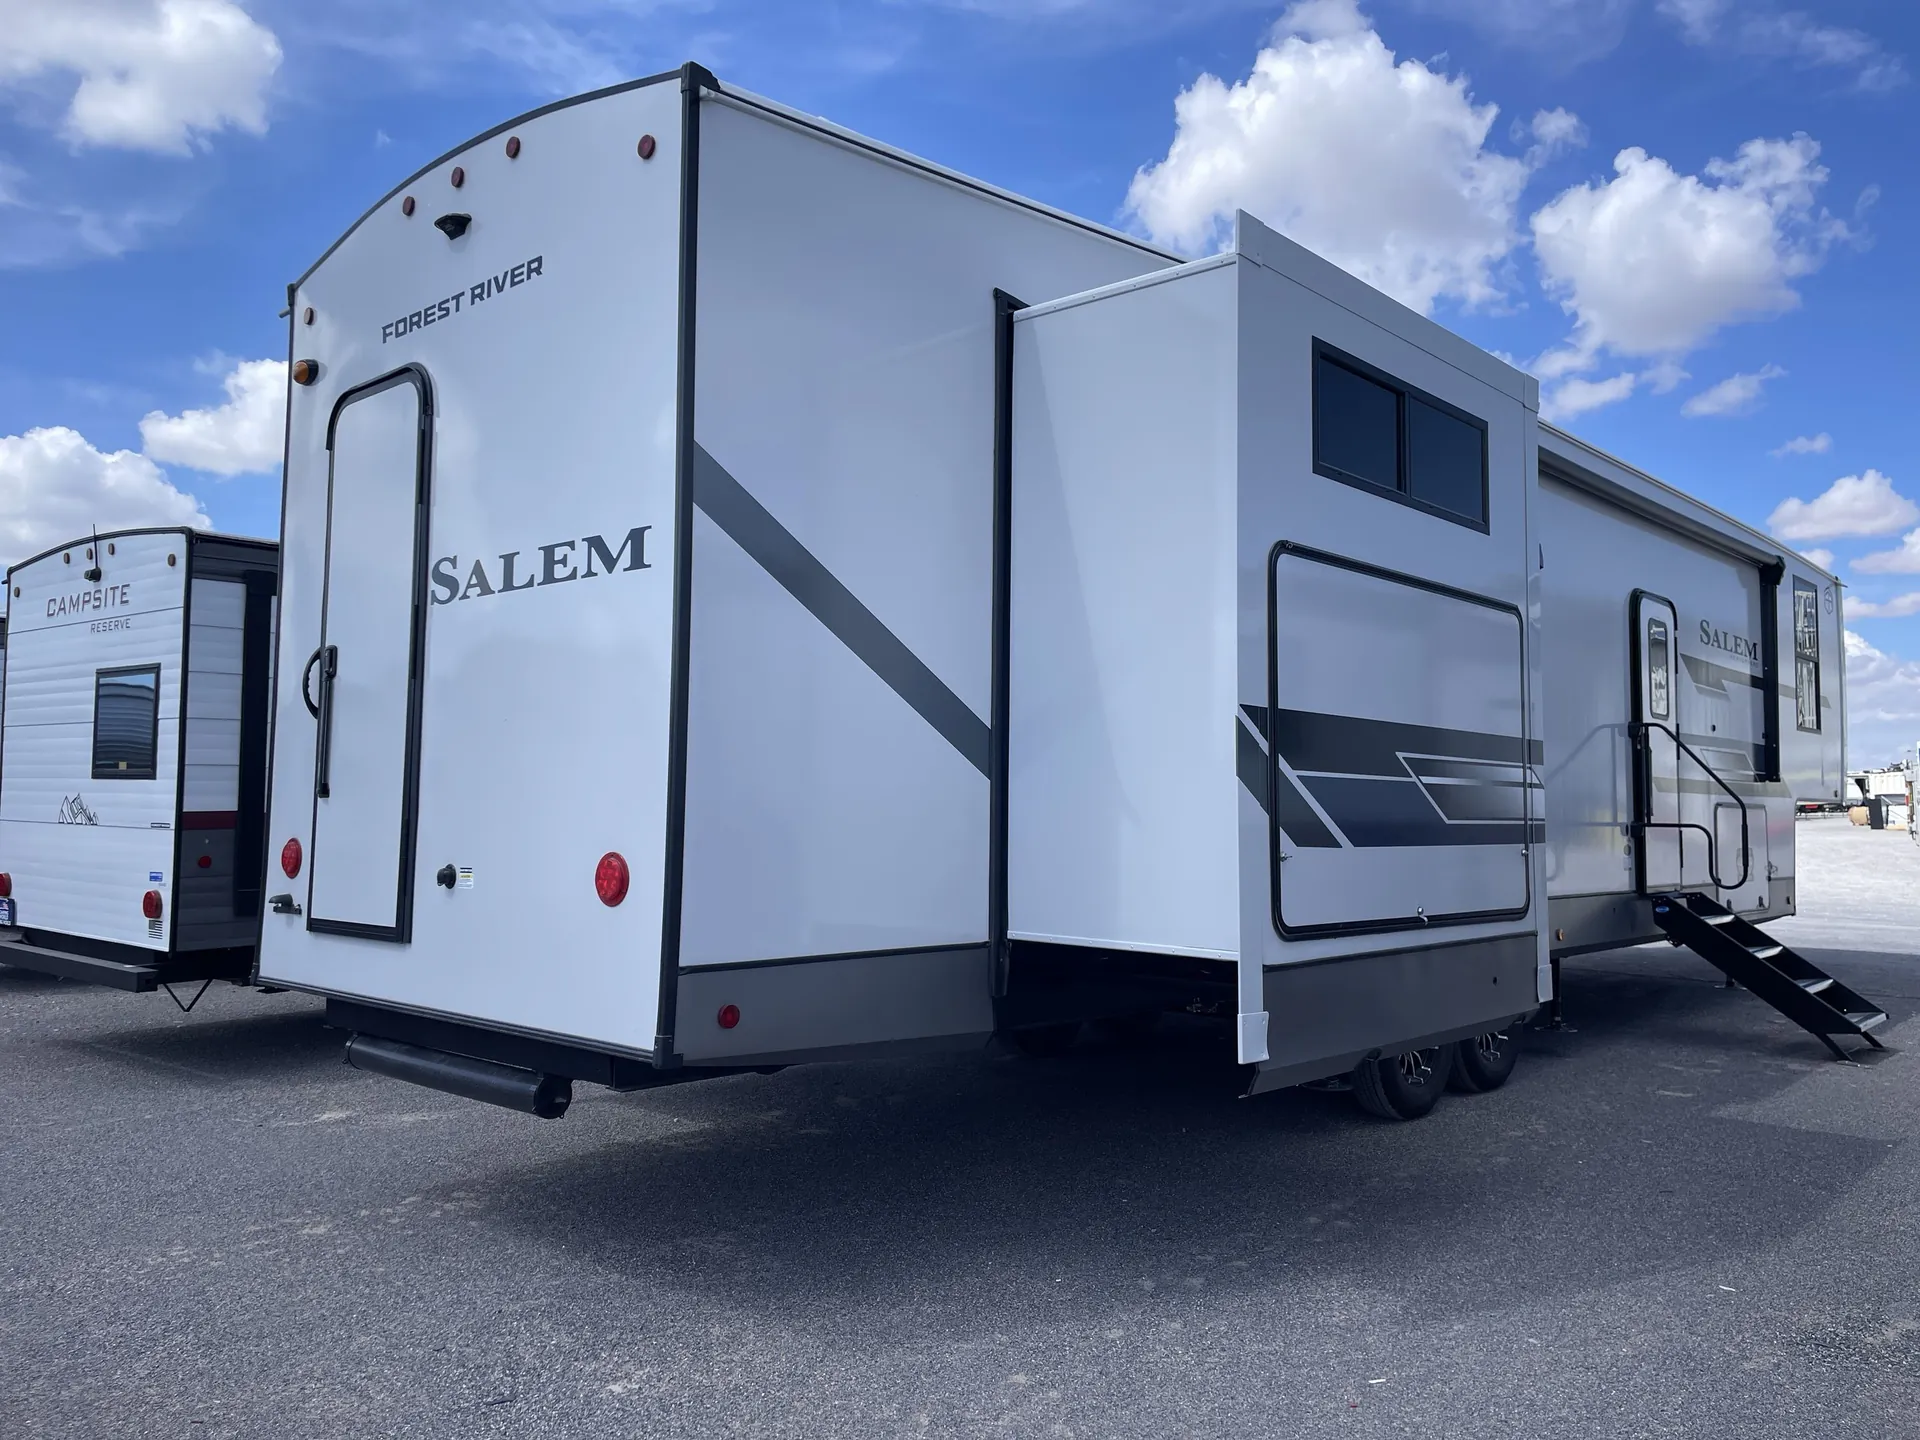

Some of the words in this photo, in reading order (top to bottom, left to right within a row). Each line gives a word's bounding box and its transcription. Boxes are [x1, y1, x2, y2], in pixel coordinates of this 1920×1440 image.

[381, 291, 465, 344] FOREST
[470, 255, 543, 306] RIVER
[430, 525, 652, 606] SALEM
[46, 583, 131, 618] CAMPSITE
[90, 618, 131, 634] RESERVE
[1700, 619, 1758, 661] SALEM
